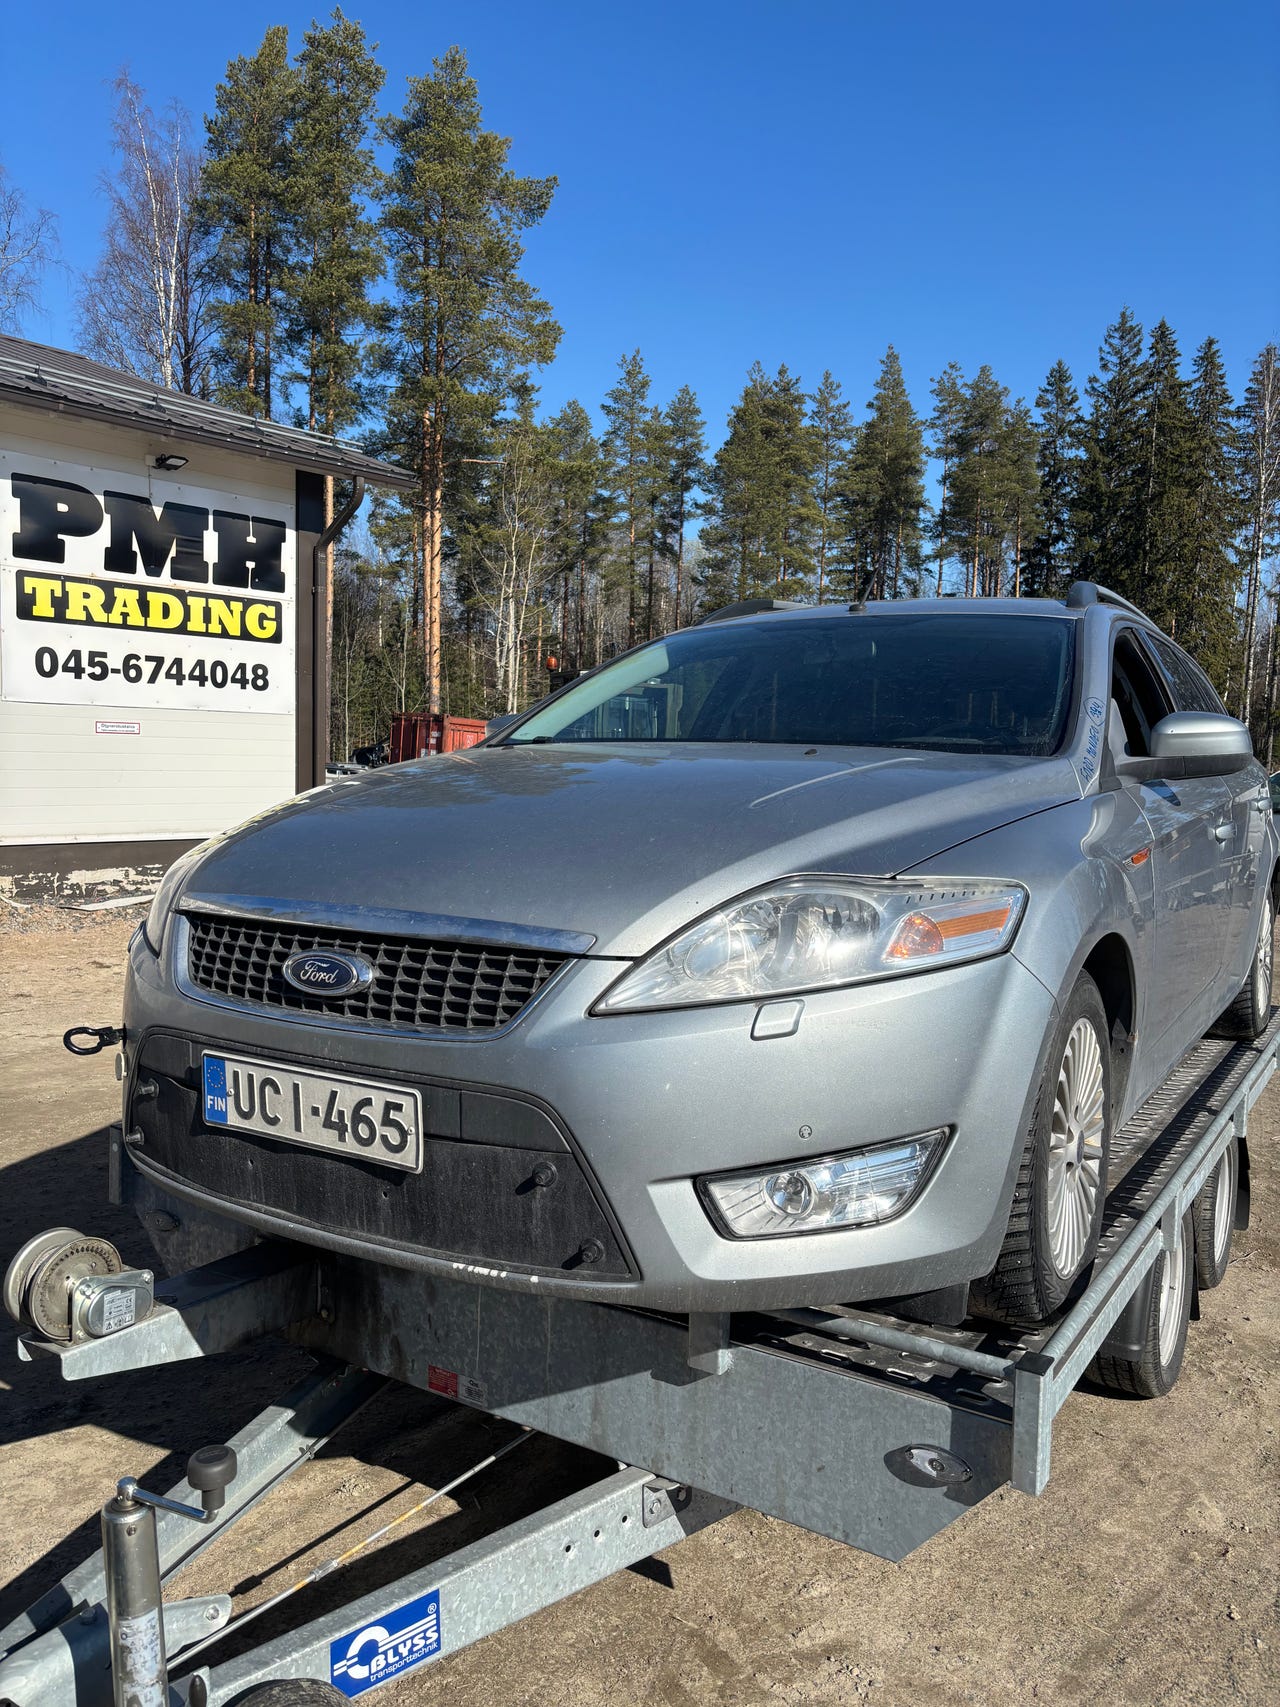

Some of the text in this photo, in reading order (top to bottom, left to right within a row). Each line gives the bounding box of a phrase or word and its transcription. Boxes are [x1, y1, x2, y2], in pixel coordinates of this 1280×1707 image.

[11, 472, 286, 593] PMH
[24, 576, 278, 639] TRADING
[35, 646, 270, 691] 045-6744048
[300, 960, 339, 984] Ford
[207, 1095, 226, 1112] FIN
[370, 1625, 439, 1675] BLYSS
[370, 1641, 438, 1682] transporttechnik
